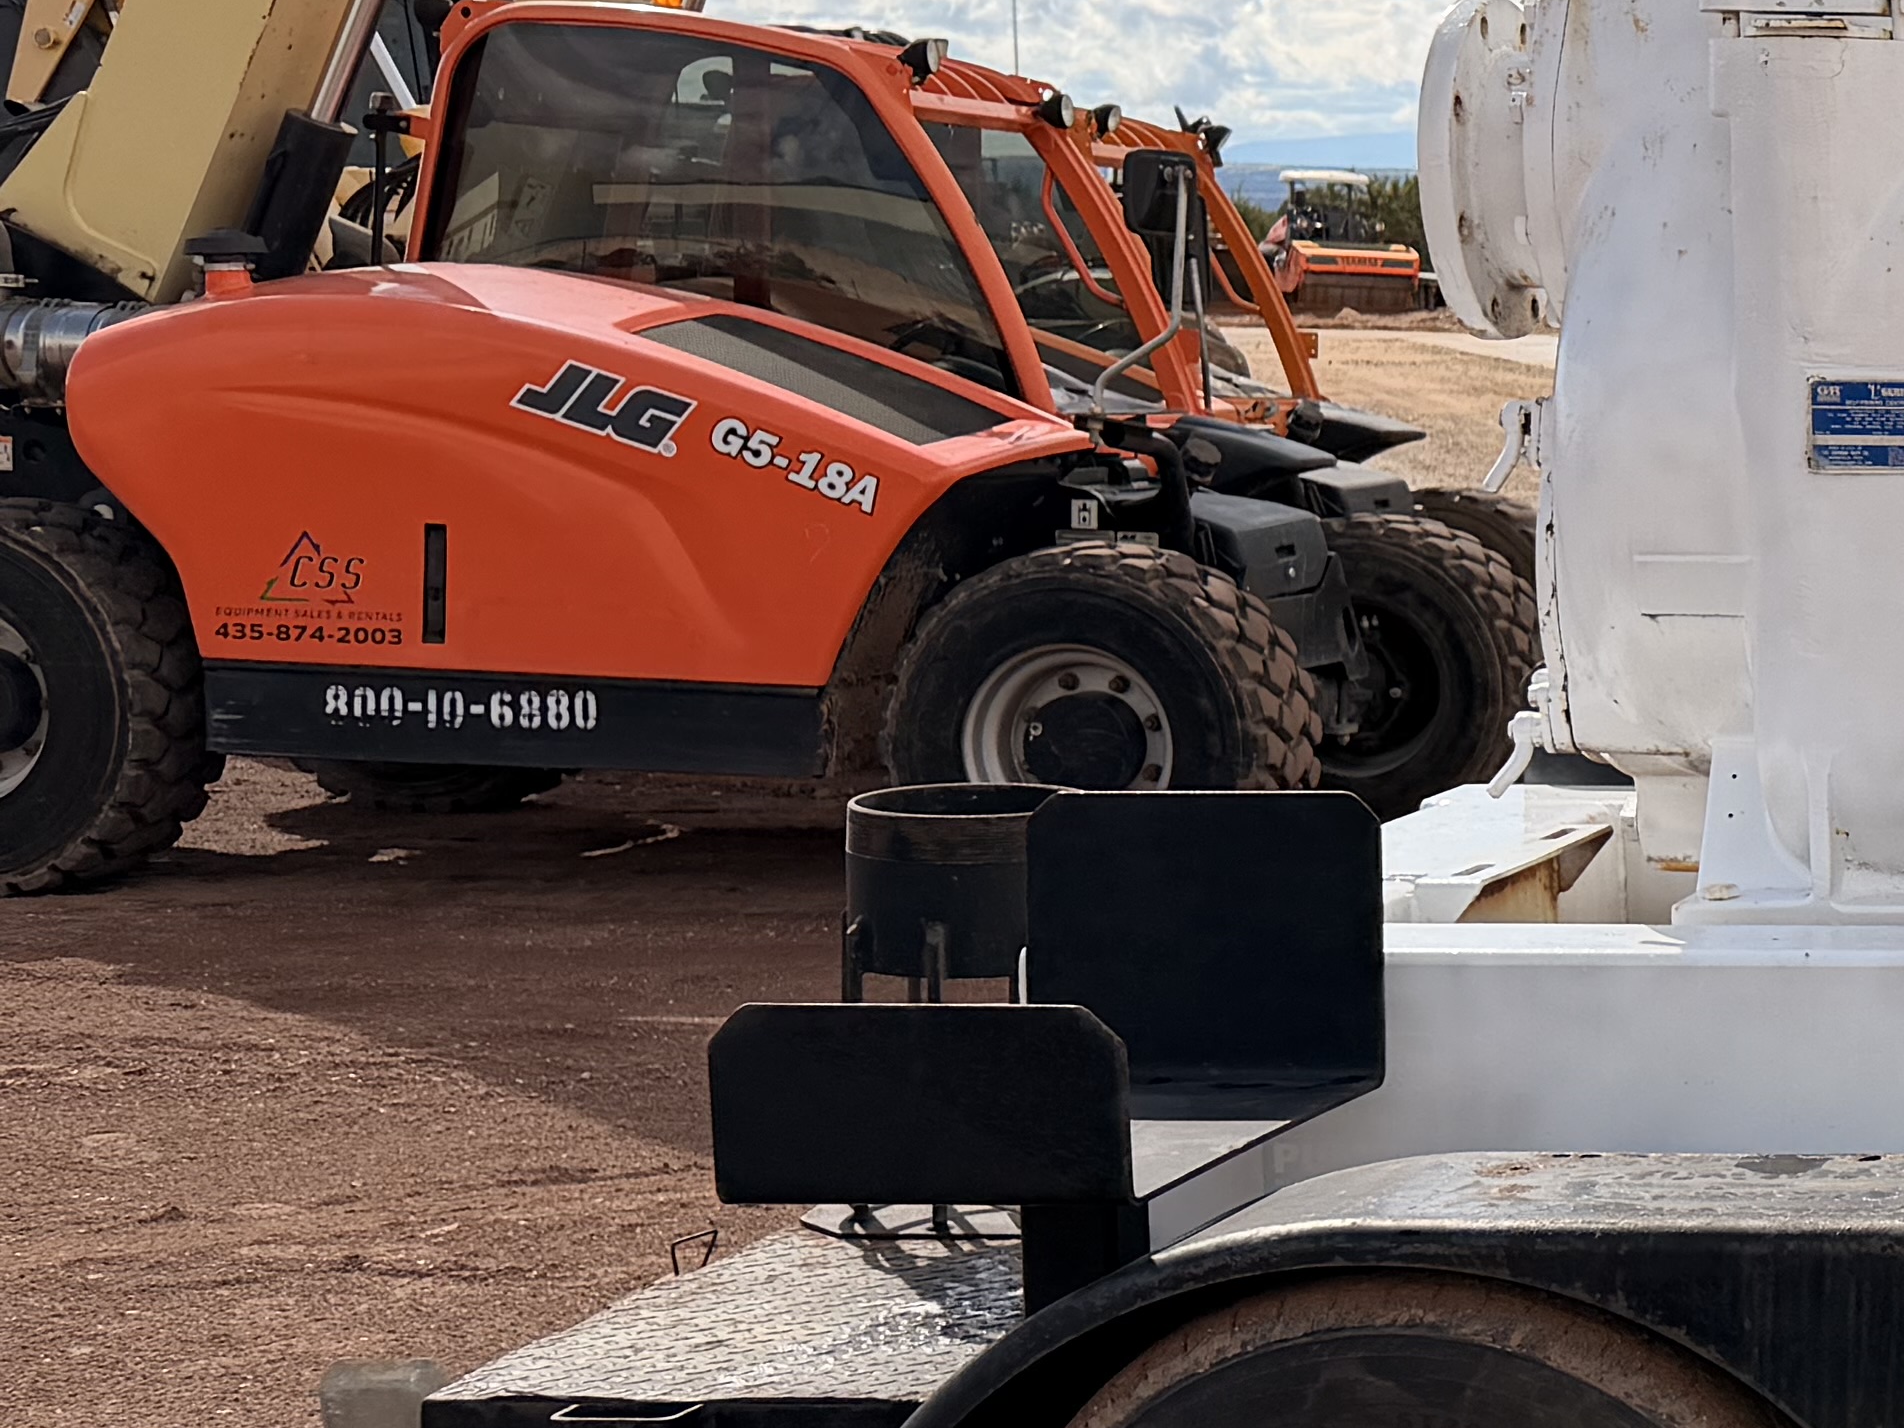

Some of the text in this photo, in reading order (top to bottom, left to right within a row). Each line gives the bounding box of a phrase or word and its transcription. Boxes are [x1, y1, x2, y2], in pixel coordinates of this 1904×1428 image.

[509, 360, 698, 454] JLG
[710, 417, 879, 515] G5-18A
[289, 555, 365, 590] CSS
[215, 606, 289, 618] EQUIPMENT
[294, 608, 332, 620] SALES
[349, 611, 403, 623] RENTALS
[215, 623, 403, 645] 435-874-2003
[325, 685, 597, 730] 800-10-6880
